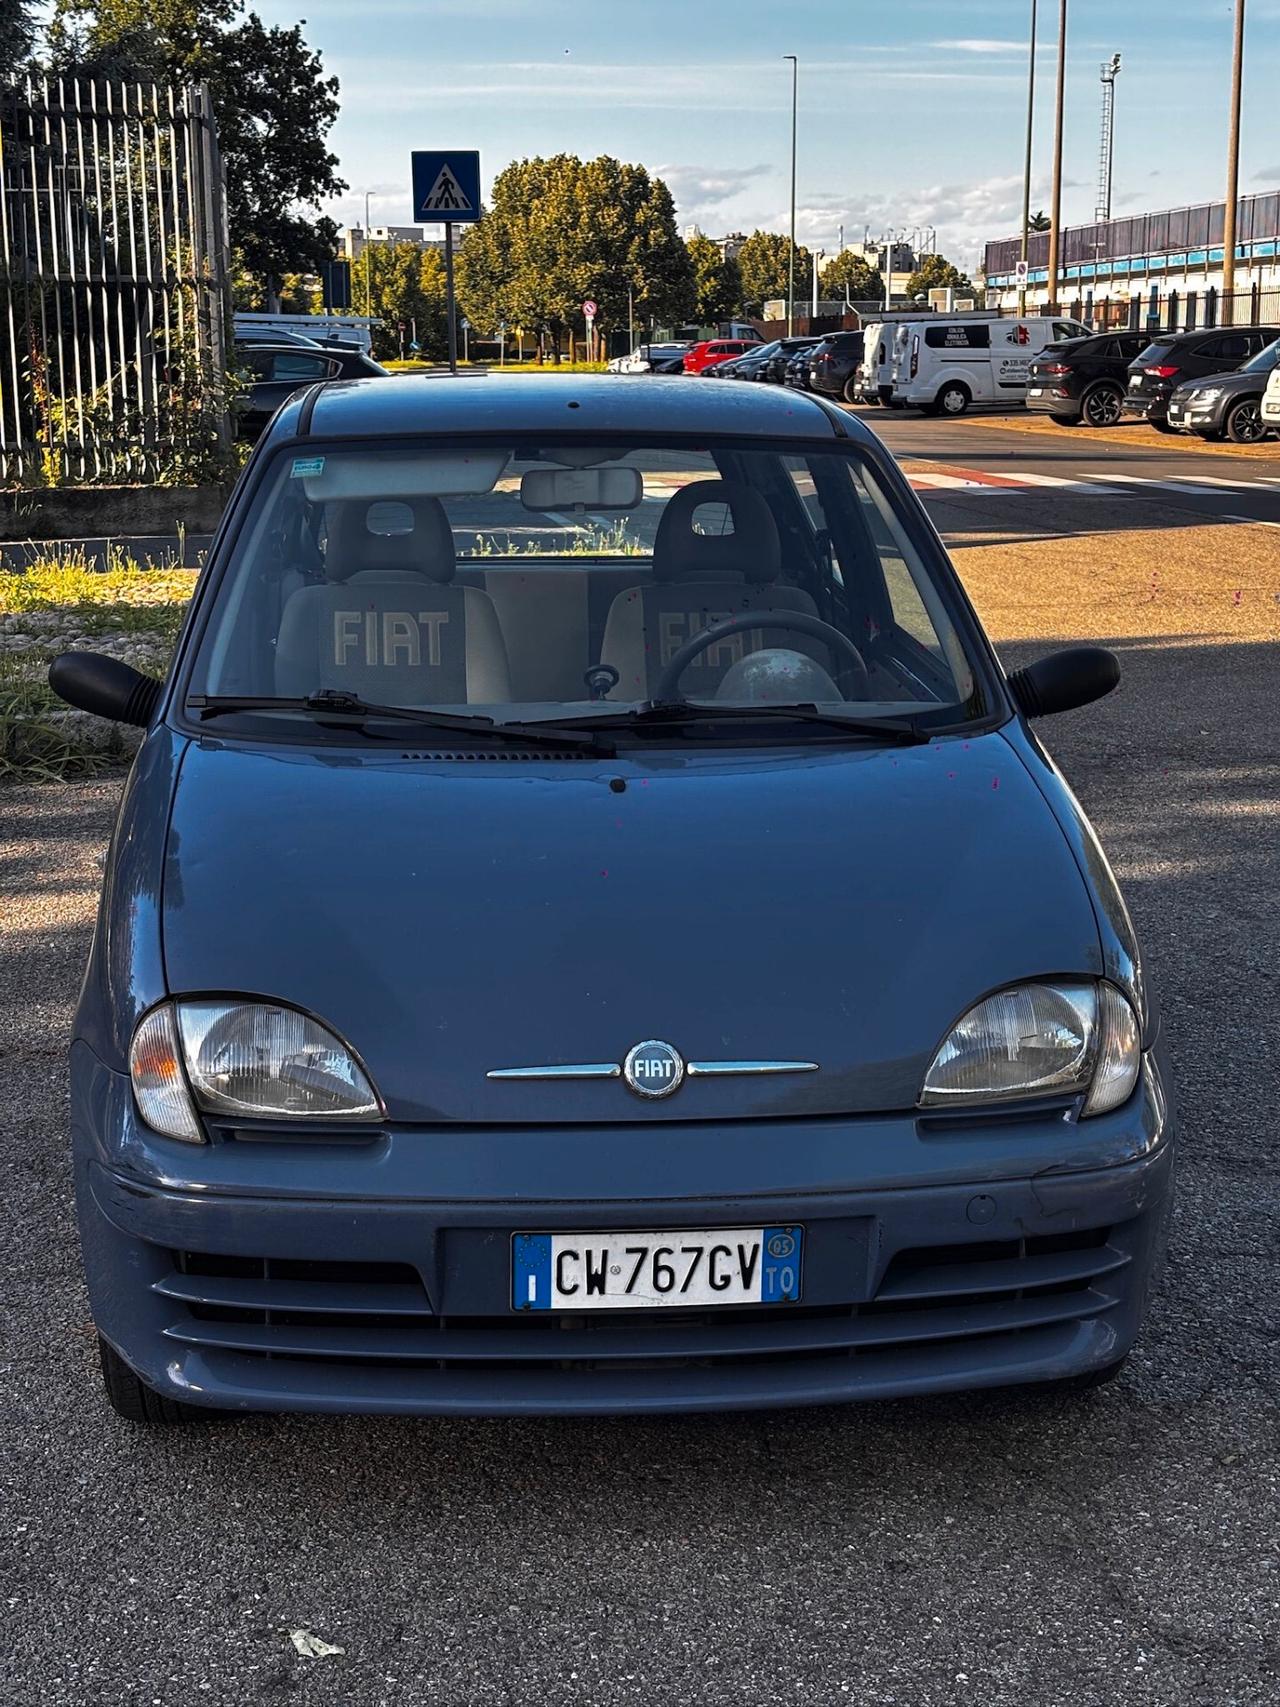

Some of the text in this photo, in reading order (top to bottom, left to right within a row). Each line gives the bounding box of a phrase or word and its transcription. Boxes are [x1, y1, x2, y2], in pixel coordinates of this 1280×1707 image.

[334, 612, 449, 666] FIAT
[634, 1059, 673, 1078] FIAT
[772, 1236, 790, 1252] 05
[528, 1243, 794, 1301] I CW 767GV TO
